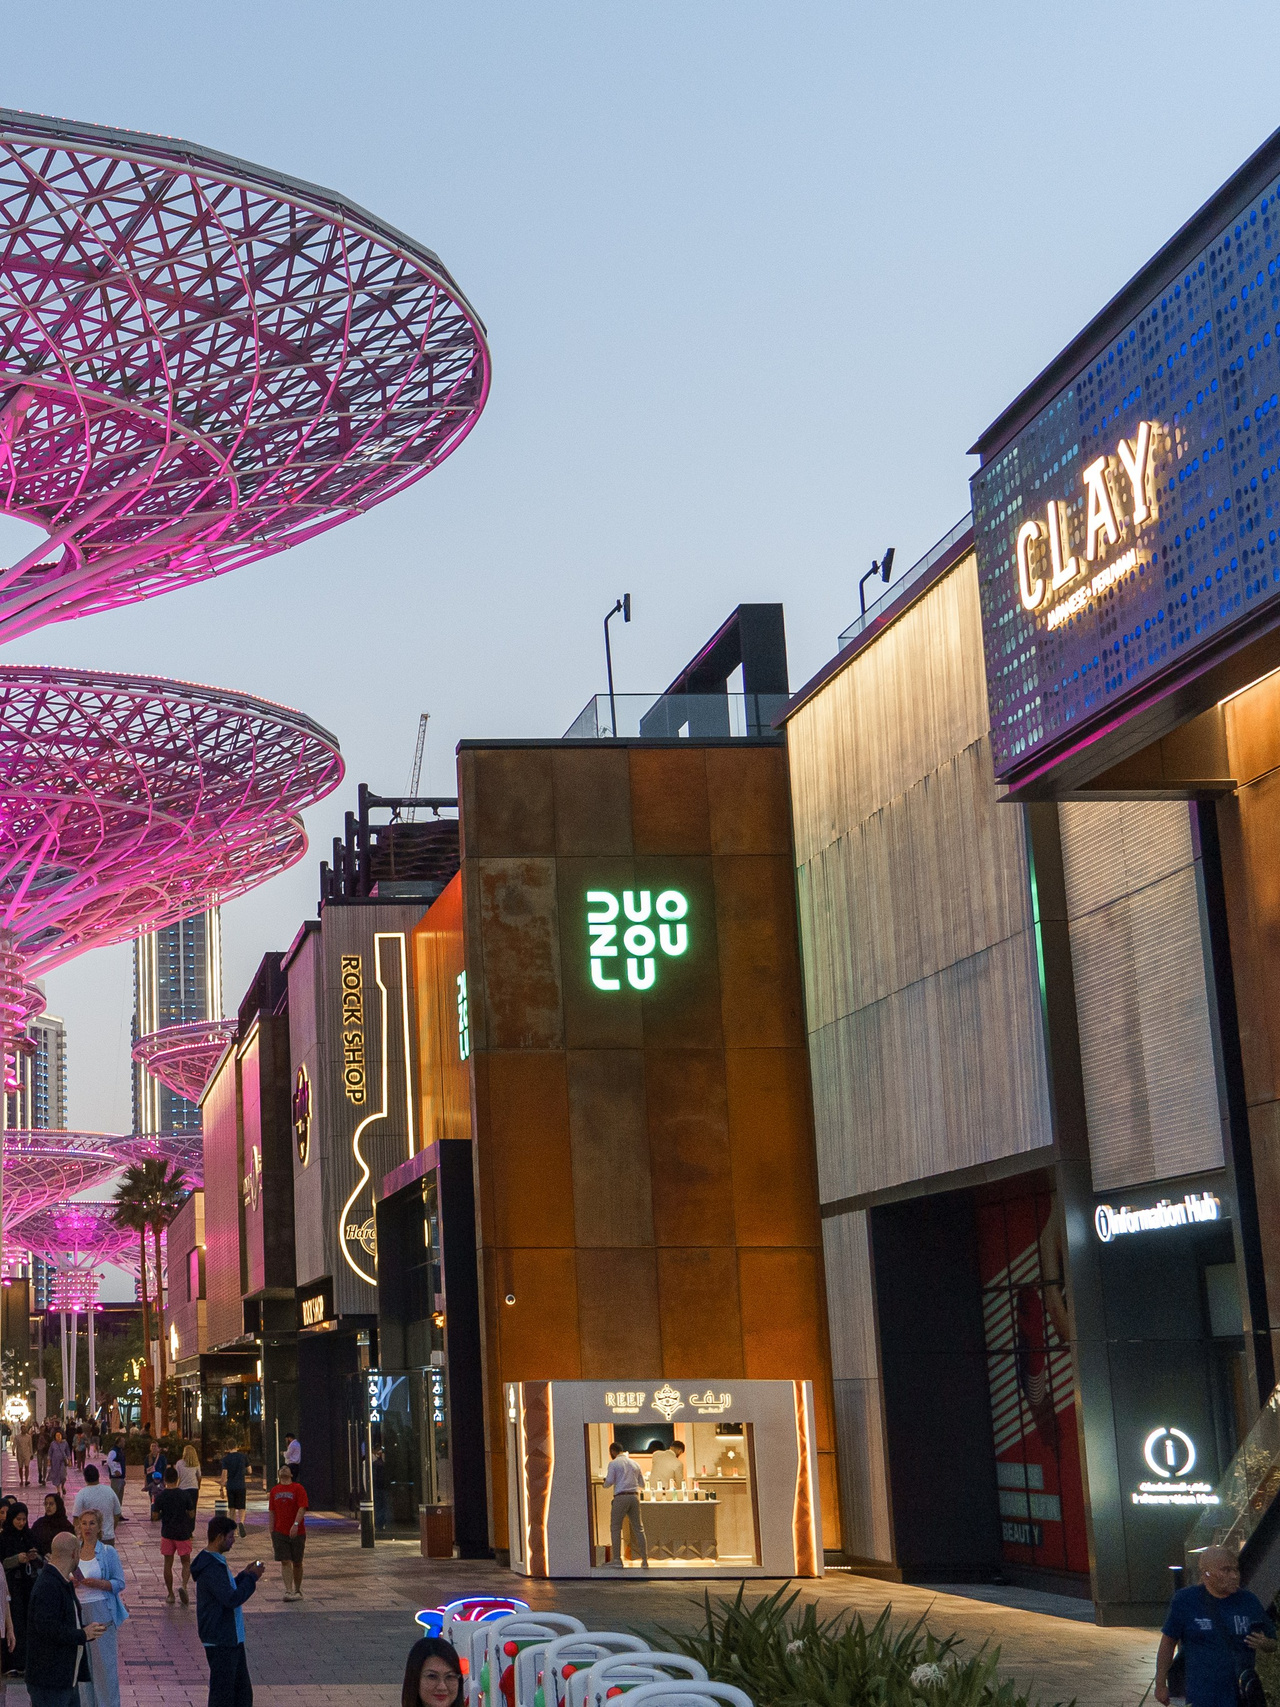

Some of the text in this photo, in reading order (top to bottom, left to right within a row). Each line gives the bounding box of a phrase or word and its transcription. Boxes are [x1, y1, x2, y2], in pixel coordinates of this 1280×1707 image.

[1017, 421, 1153, 610] CLAY
[586, 890, 688, 922] DUO
[589, 924, 688, 956] ZOU
[590, 958, 656, 990] LU
[342, 955, 366, 1104] ROCK SHOP
[1109, 1200, 1187, 1235] Information
[1184, 1191, 1218, 1223] Hub
[605, 1391, 646, 1407] REEF
[1002, 1522, 1040, 1546] BEAUTY
